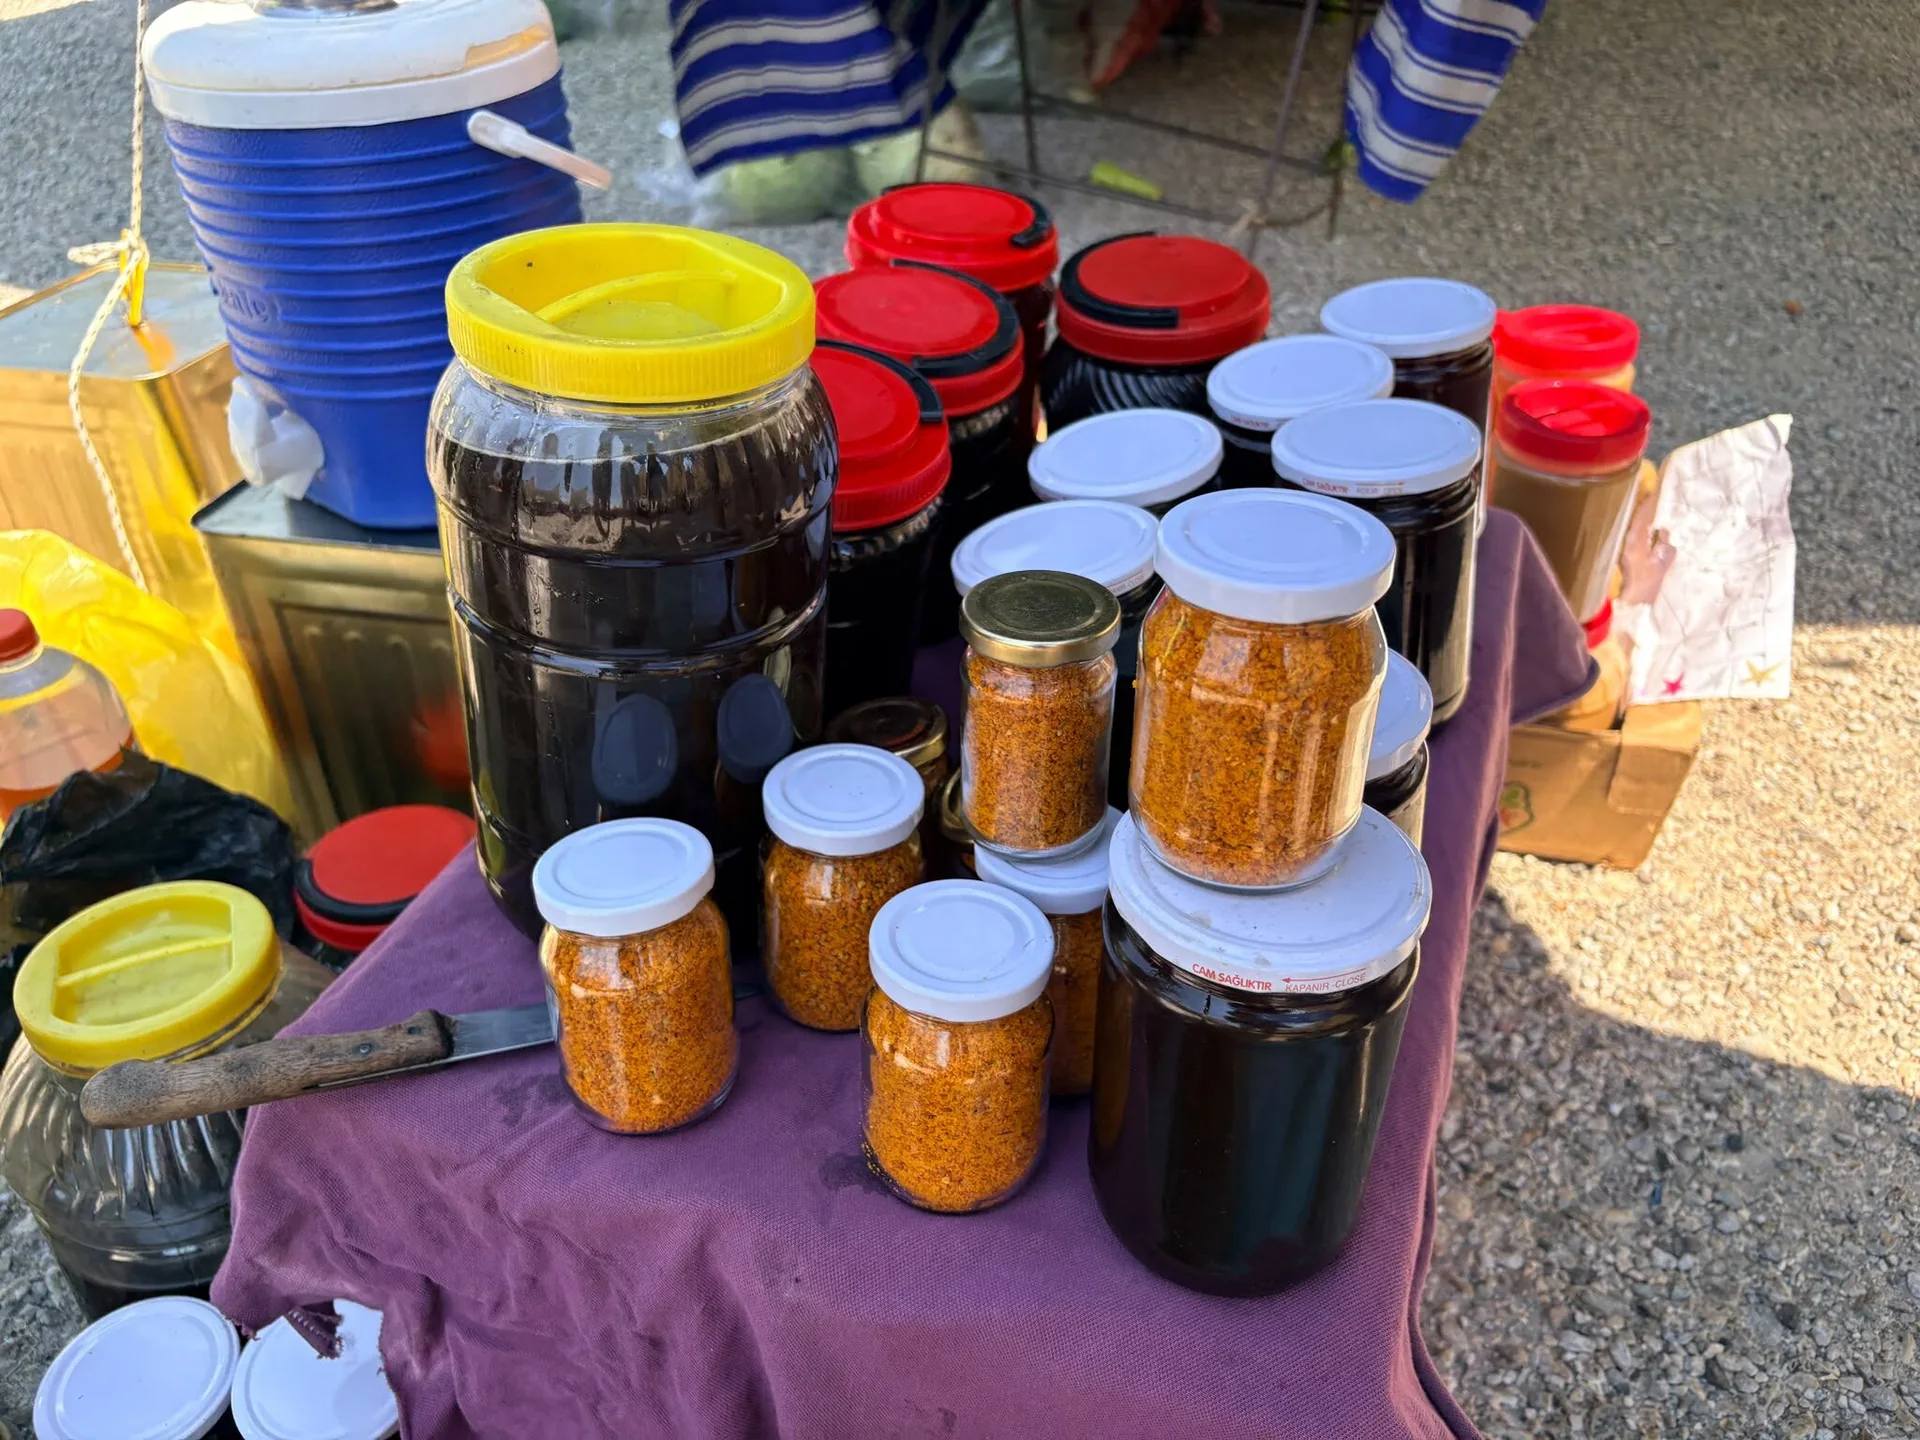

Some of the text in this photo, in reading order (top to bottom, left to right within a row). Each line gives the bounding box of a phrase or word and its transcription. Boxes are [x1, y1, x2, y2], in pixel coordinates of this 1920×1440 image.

[1192, 963, 1272, 991] CAM SAĞLIKTIR
[1285, 982, 1330, 993] KAPANIR
